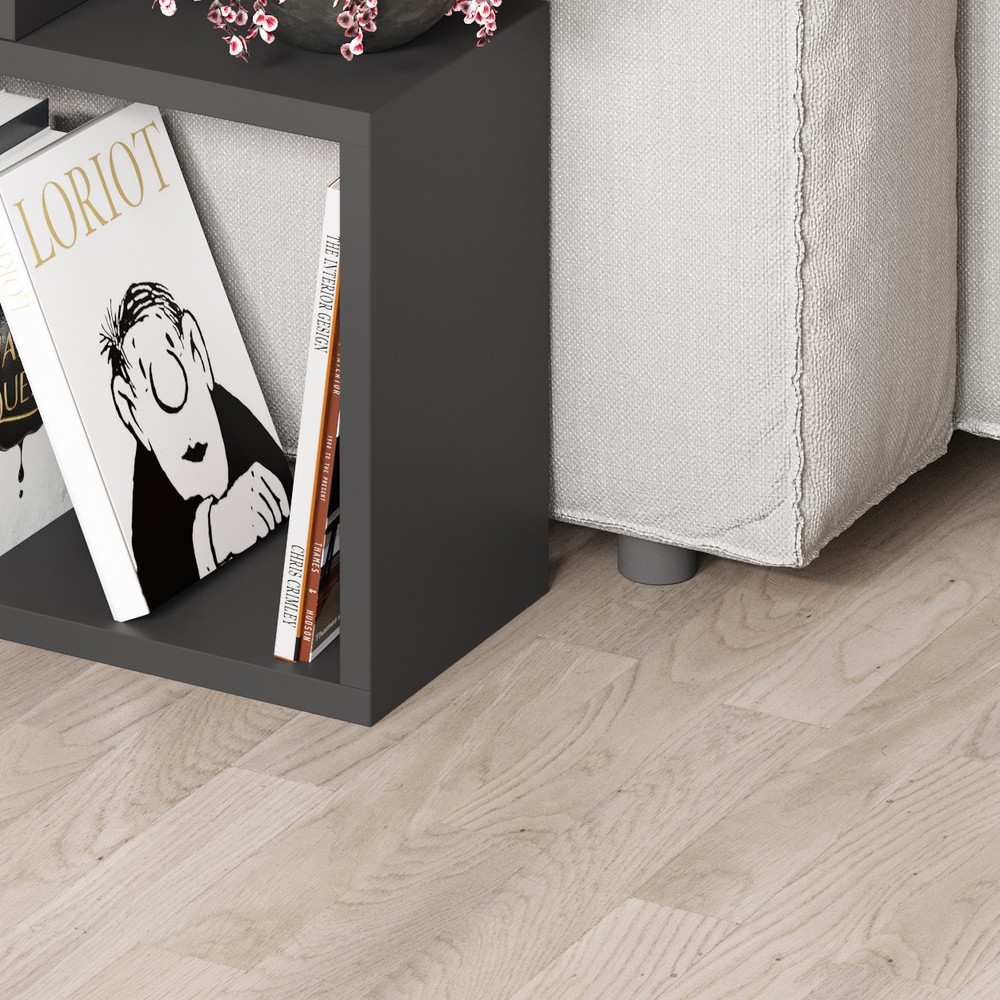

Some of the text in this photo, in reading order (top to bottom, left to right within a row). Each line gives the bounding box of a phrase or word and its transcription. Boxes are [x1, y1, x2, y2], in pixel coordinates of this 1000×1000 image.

[13, 121, 170, 269] LORIOT
[325, 234, 340, 260] THE
[318, 258, 338, 312] INTERIOR
[319, 476, 329, 502] PRESENT
[290, 544, 305, 579] CHRIS
[311, 542, 323, 574] THAMES
[302, 609, 314, 643] HUDSON
